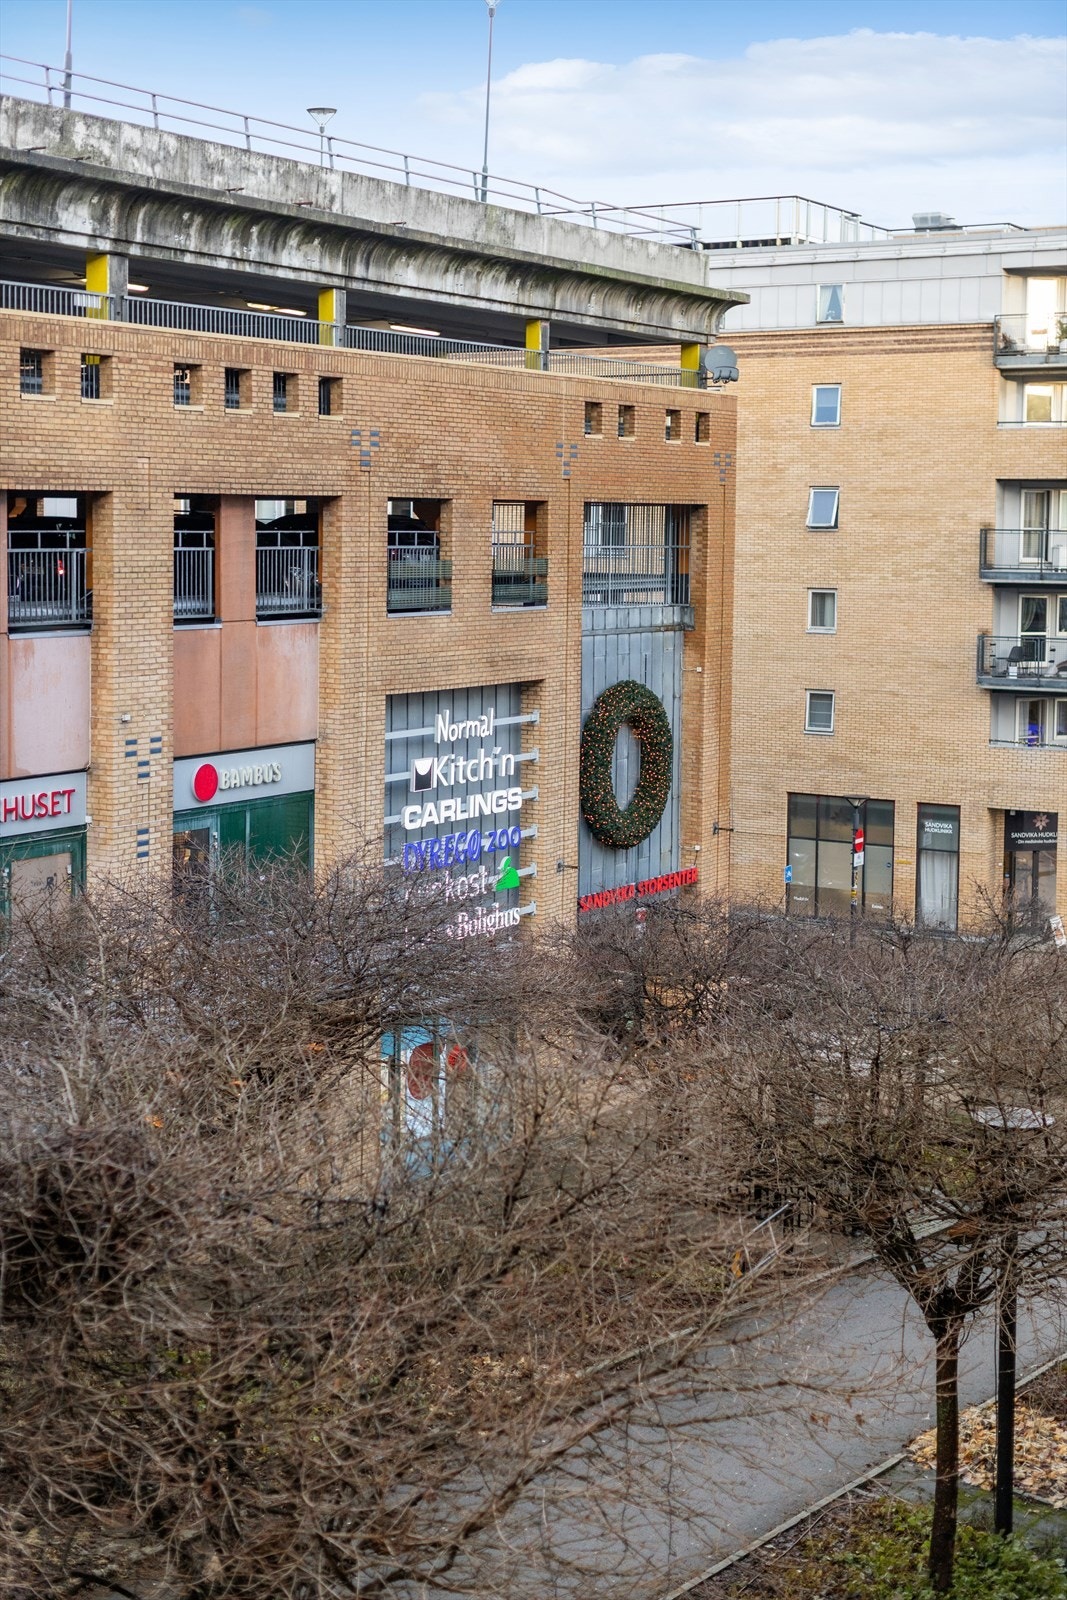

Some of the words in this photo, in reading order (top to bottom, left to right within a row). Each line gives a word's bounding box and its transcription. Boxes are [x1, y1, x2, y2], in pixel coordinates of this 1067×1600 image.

[435, 707, 494, 744] Normal
[219, 763, 282, 790] BAMBUS
[402, 787, 523, 830] CARLINGS
[924, 821, 953, 829] SANDVIKA
[578, 883, 636, 912] SANDVIKA
[636, 866, 698, 897] STORSENTER
[457, 902, 521, 940] Bolighus
